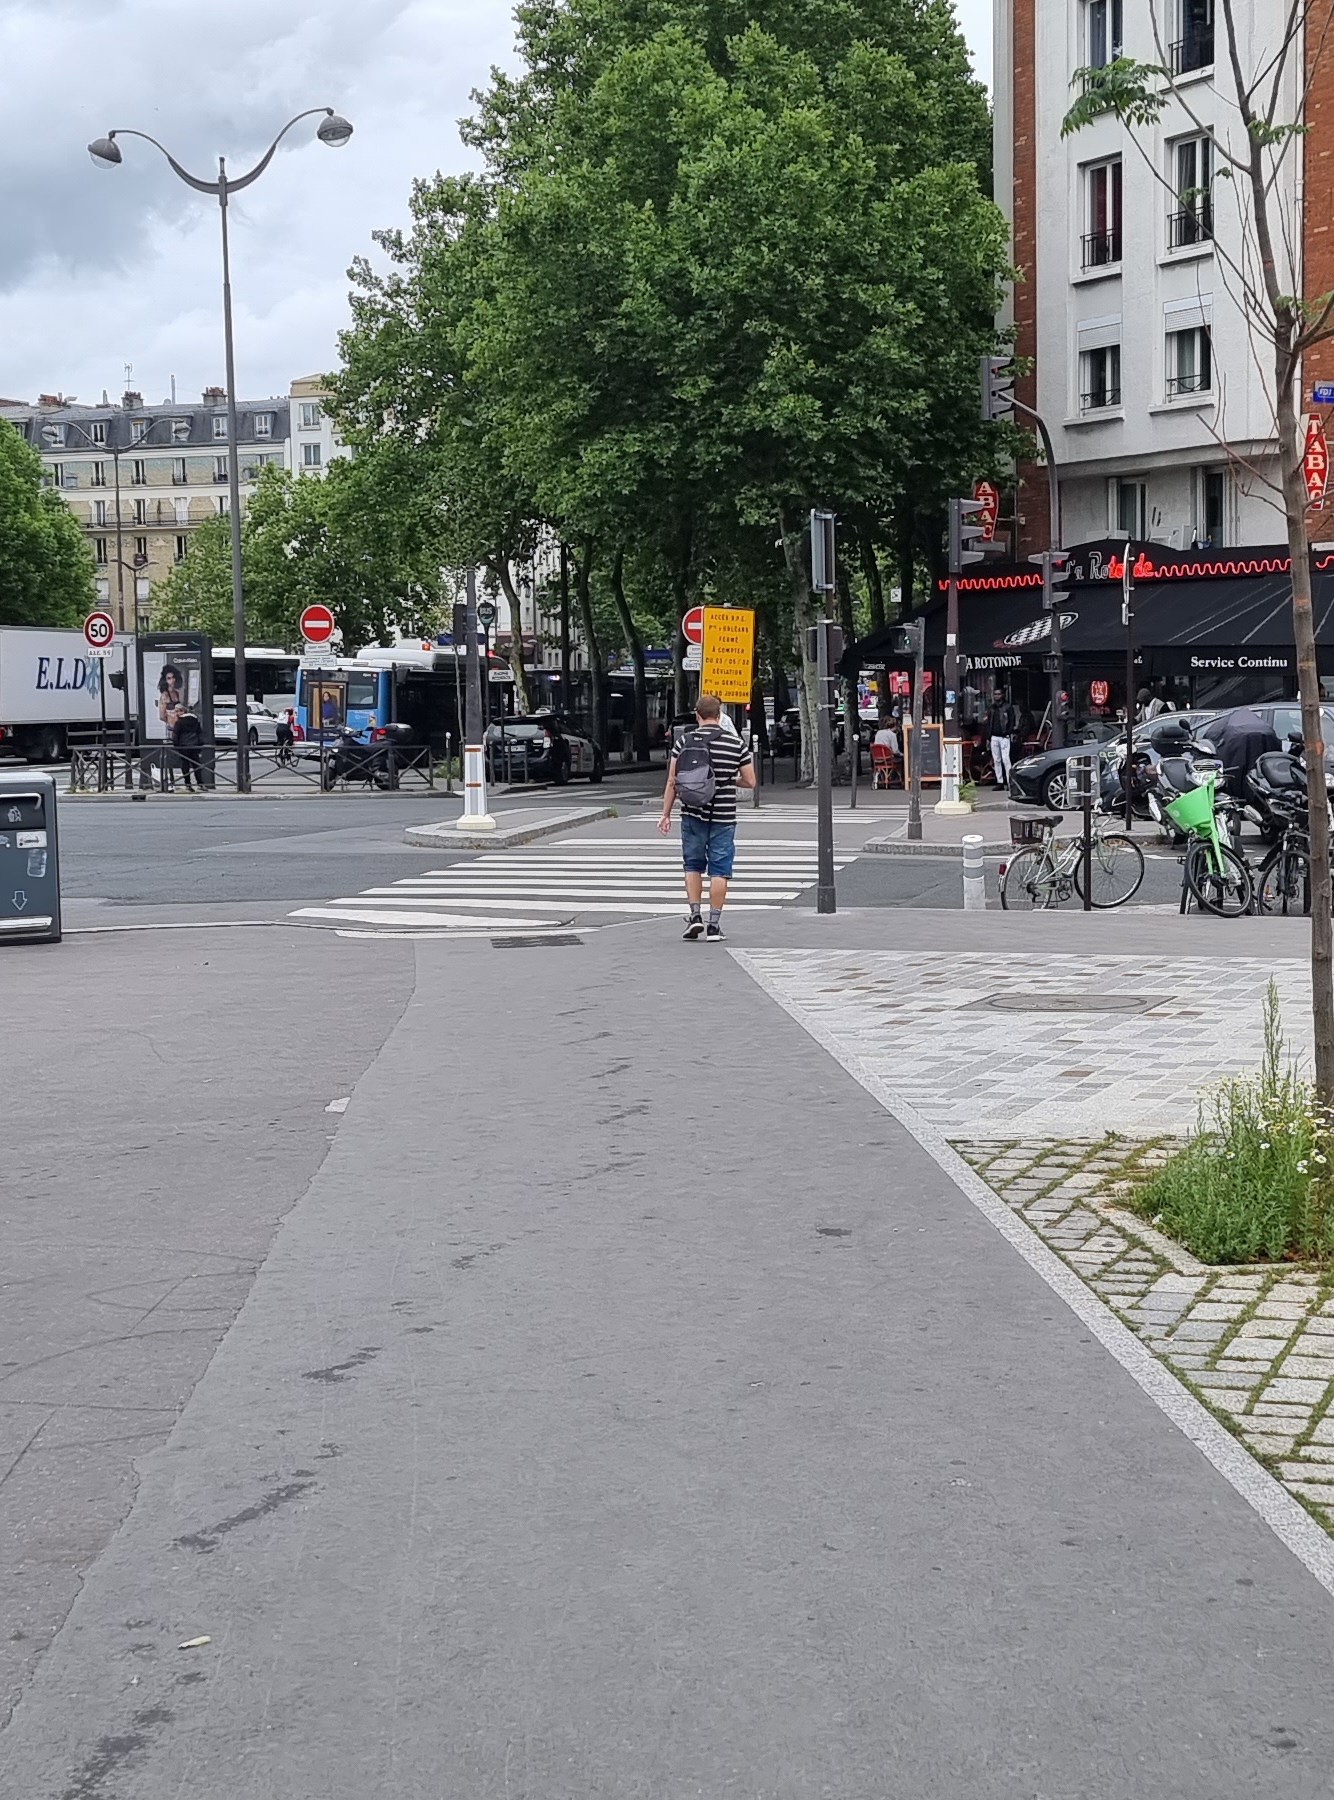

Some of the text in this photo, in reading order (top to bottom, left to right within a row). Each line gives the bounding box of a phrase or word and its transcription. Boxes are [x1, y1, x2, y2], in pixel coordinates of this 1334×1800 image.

[1307, 420, 1324, 504] TABAC
[977, 481, 995, 538] ABAC
[1089, 551, 1154, 579] Rotode
[90, 624, 108, 638] 50
[718, 647, 745, 655] COMPTER
[975, 655, 1022, 668] ROTONDE
[1190, 656, 1288, 668] Service Continu
[36, 657, 87, 690] E.L.D
